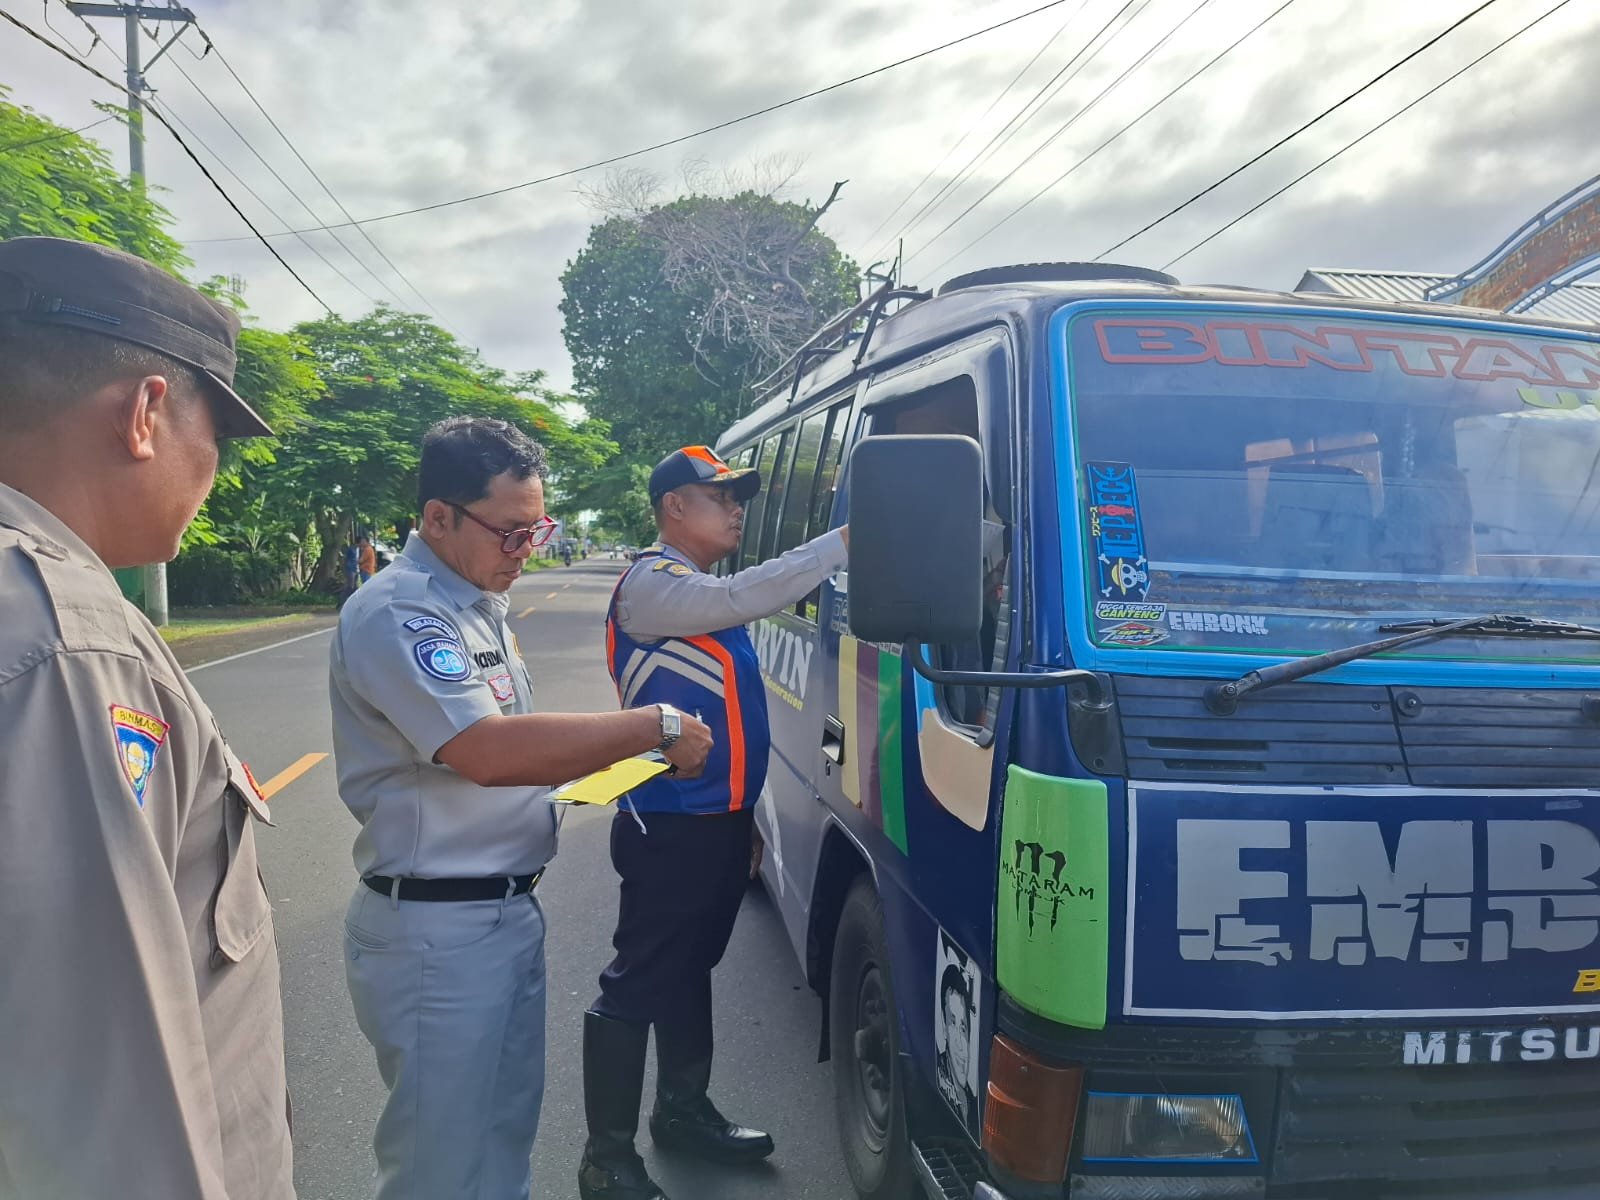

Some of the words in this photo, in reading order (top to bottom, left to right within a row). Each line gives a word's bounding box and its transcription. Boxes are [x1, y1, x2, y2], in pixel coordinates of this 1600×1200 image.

[1099, 609, 1160, 620] GANTENG
[119, 710, 158, 734] BINMAS
[1003, 860, 1094, 901] MATARAM
[1402, 1027, 1600, 1064] MITSU
